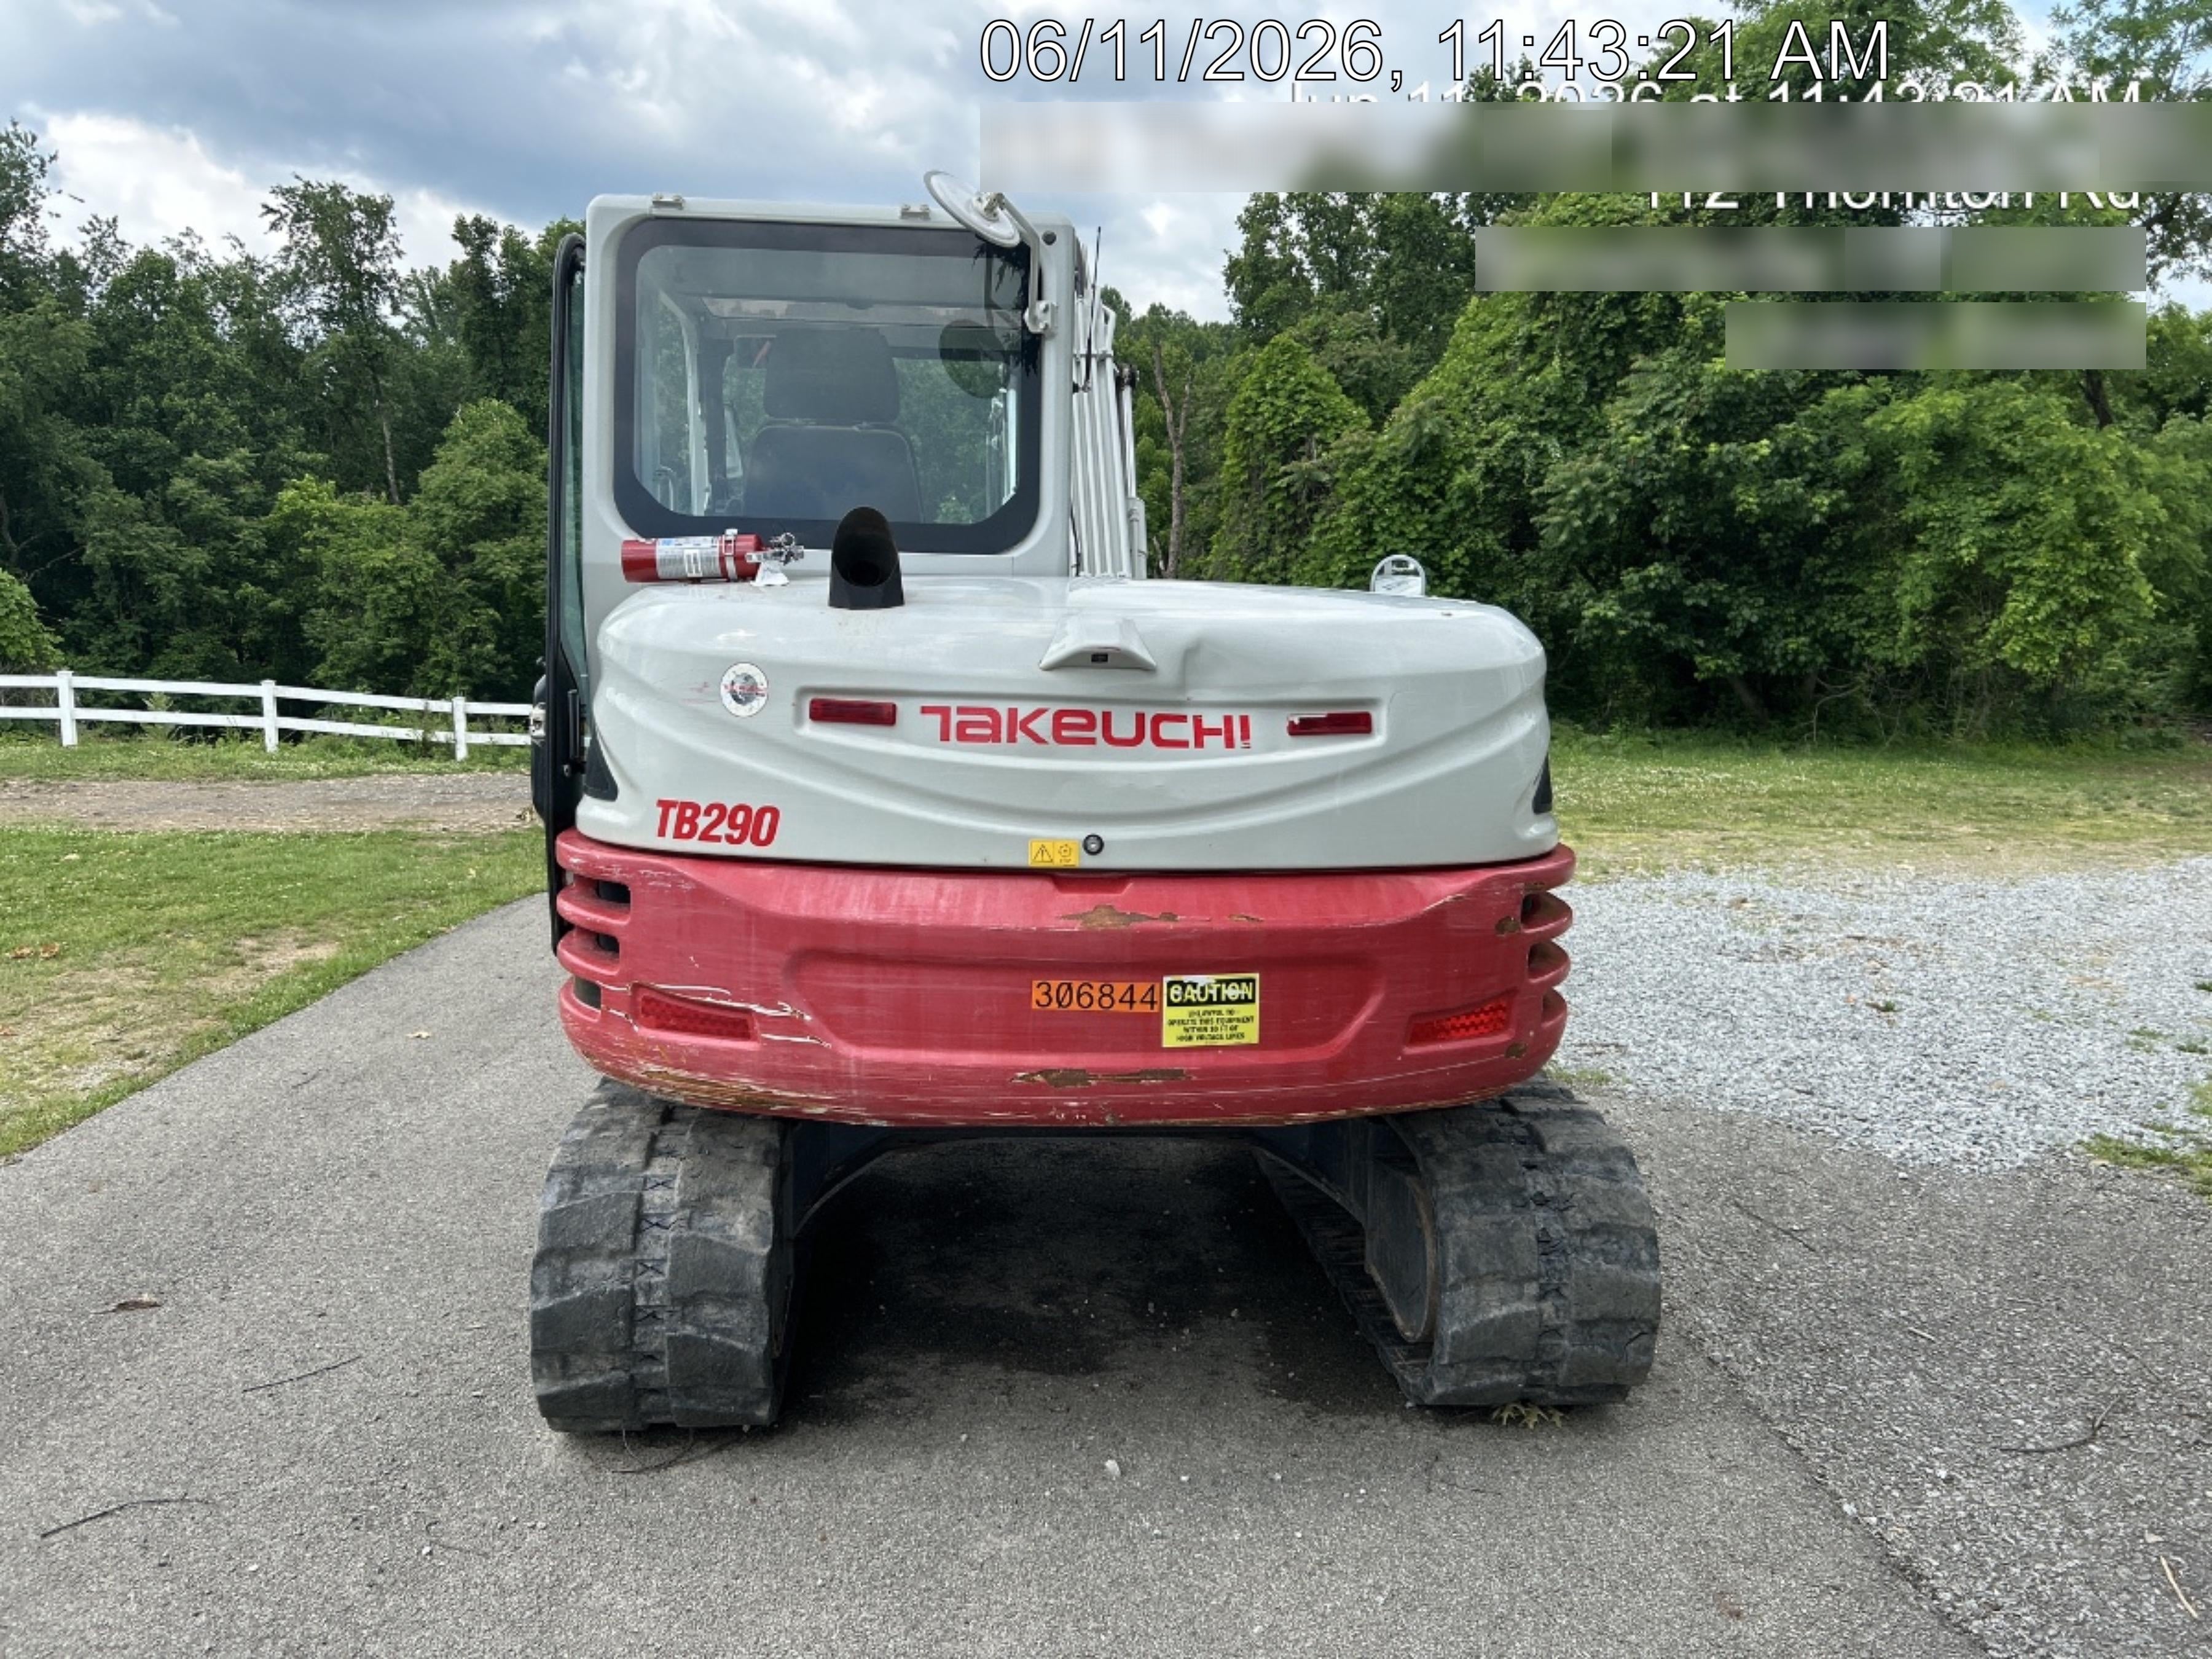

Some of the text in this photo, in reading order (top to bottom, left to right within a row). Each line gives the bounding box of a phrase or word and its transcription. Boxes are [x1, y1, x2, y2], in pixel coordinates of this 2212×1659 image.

[656, 799, 780, 847] TB290
[1035, 981, 1158, 1011] 306844
[1169, 982, 1253, 1003] CAUTION
